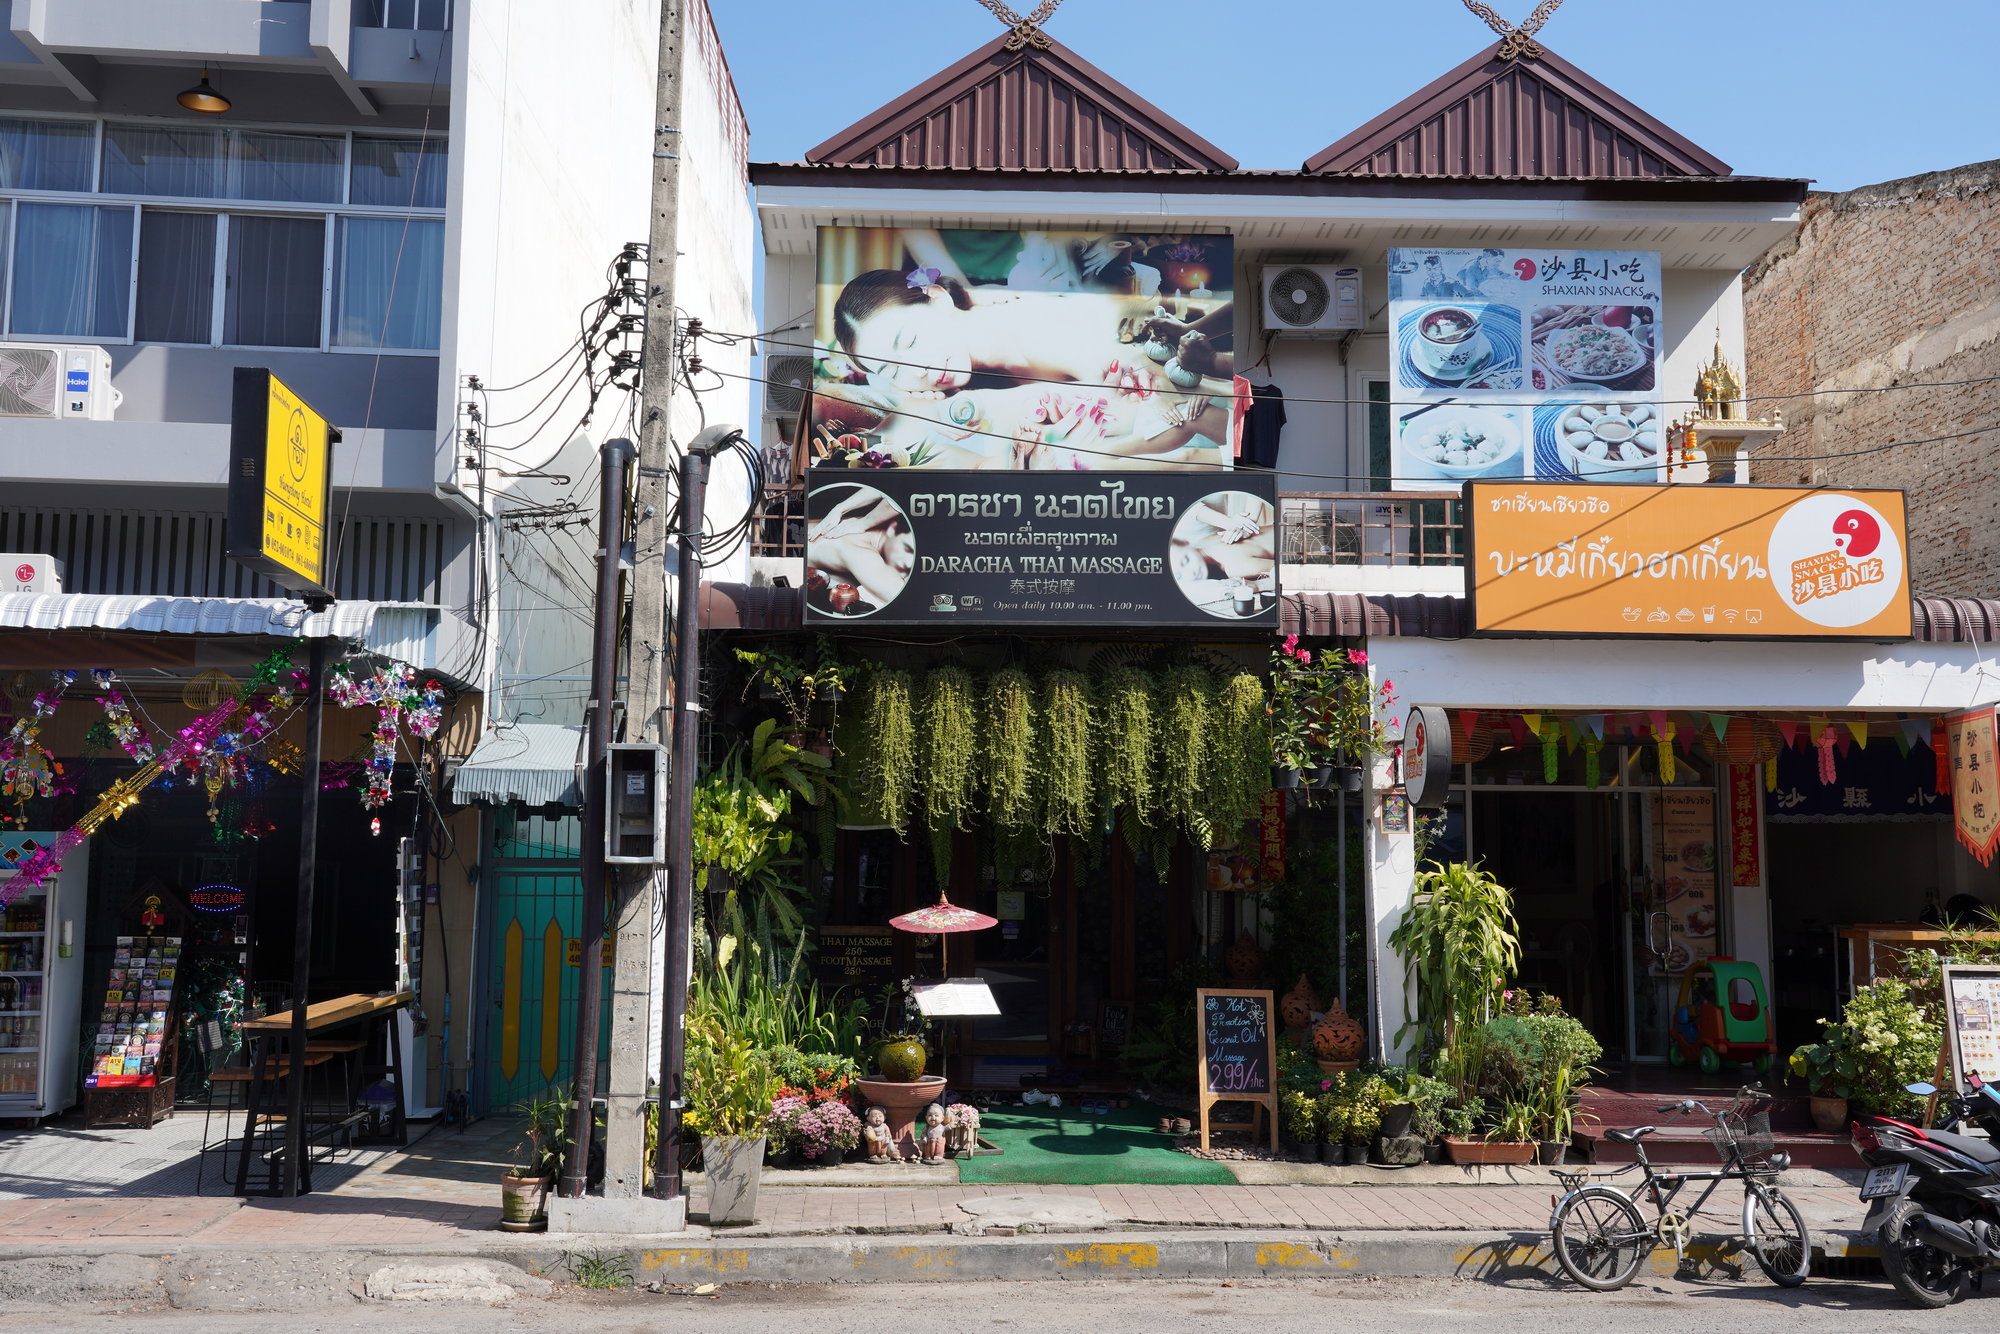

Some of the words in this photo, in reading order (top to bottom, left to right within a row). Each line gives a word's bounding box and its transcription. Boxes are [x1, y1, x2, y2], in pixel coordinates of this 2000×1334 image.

[1541, 255, 1645, 282] 沙县小吃
[1541, 285, 1595, 296] SHAXIAN
[1598, 286, 1644, 297] SNACKS
[67, 377, 89, 386] Haier
[909, 493, 1022, 517] ดารชา
[1034, 480, 1176, 520] นวดไทย
[964, 521, 1118, 552] นวดเพื่อสุขภาพ
[921, 556, 1013, 575] DARACHA
[1020, 556, 1066, 575] THAI
[1071, 557, 1163, 575] MASSAGE
[1793, 553, 1838, 571] SHAXIAN
[1794, 559, 1845, 581] SNACKS
[1009, 579, 1076, 596] 泰式按摩
[1793, 561, 1882, 602] 沙县小吃
[992, 600, 1019, 612] Open
[1021, 600, 1046, 611] daily
[1049, 601, 1075, 610] 10.00
[1106, 602, 1132, 610] 11.00
[1134, 603, 1153, 611] pm.
[190, 893, 246, 904] WELCOME
[820, 937, 846, 946] THAI
[848, 937, 893, 946] MASSAGE
[1226, 997, 1246, 1012] Hot
